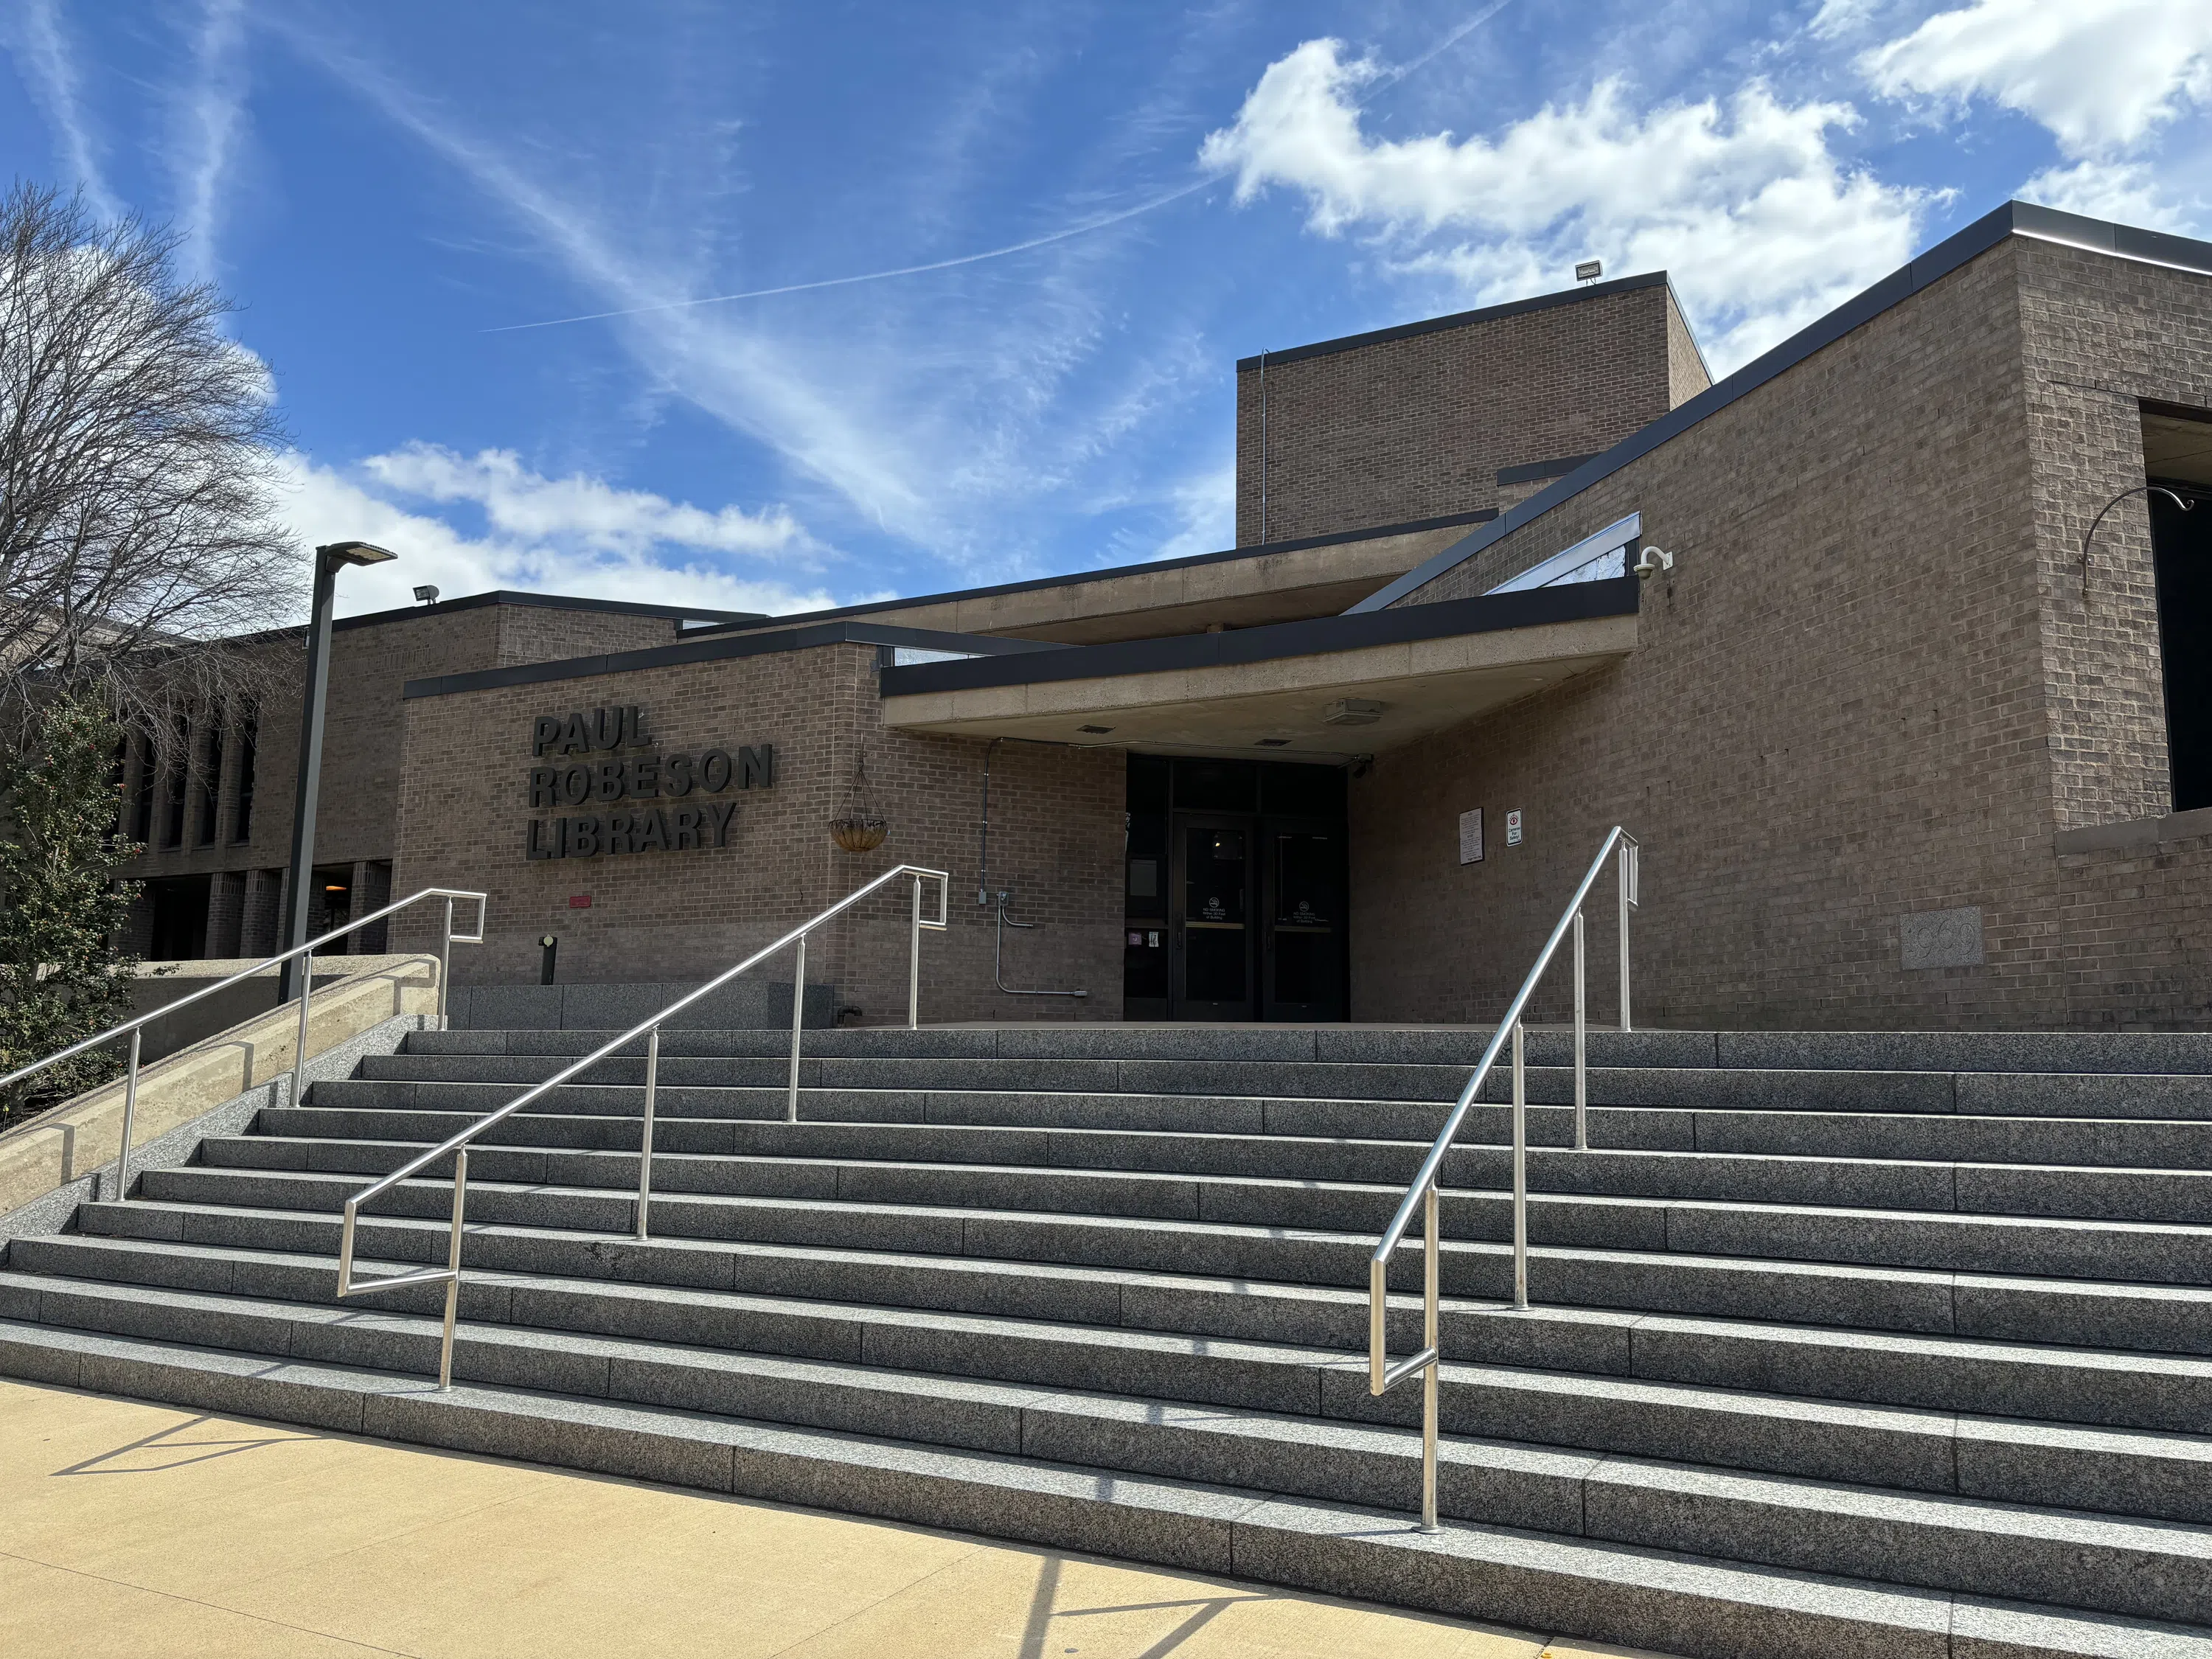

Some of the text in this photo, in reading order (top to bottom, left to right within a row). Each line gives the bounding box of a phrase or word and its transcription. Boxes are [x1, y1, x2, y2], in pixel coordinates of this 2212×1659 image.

[532, 706, 653, 757] PAUL
[529, 743, 773, 808] ROBESON
[526, 802, 737, 861] LIBRARY
[1906, 917, 1976, 959] 1969
